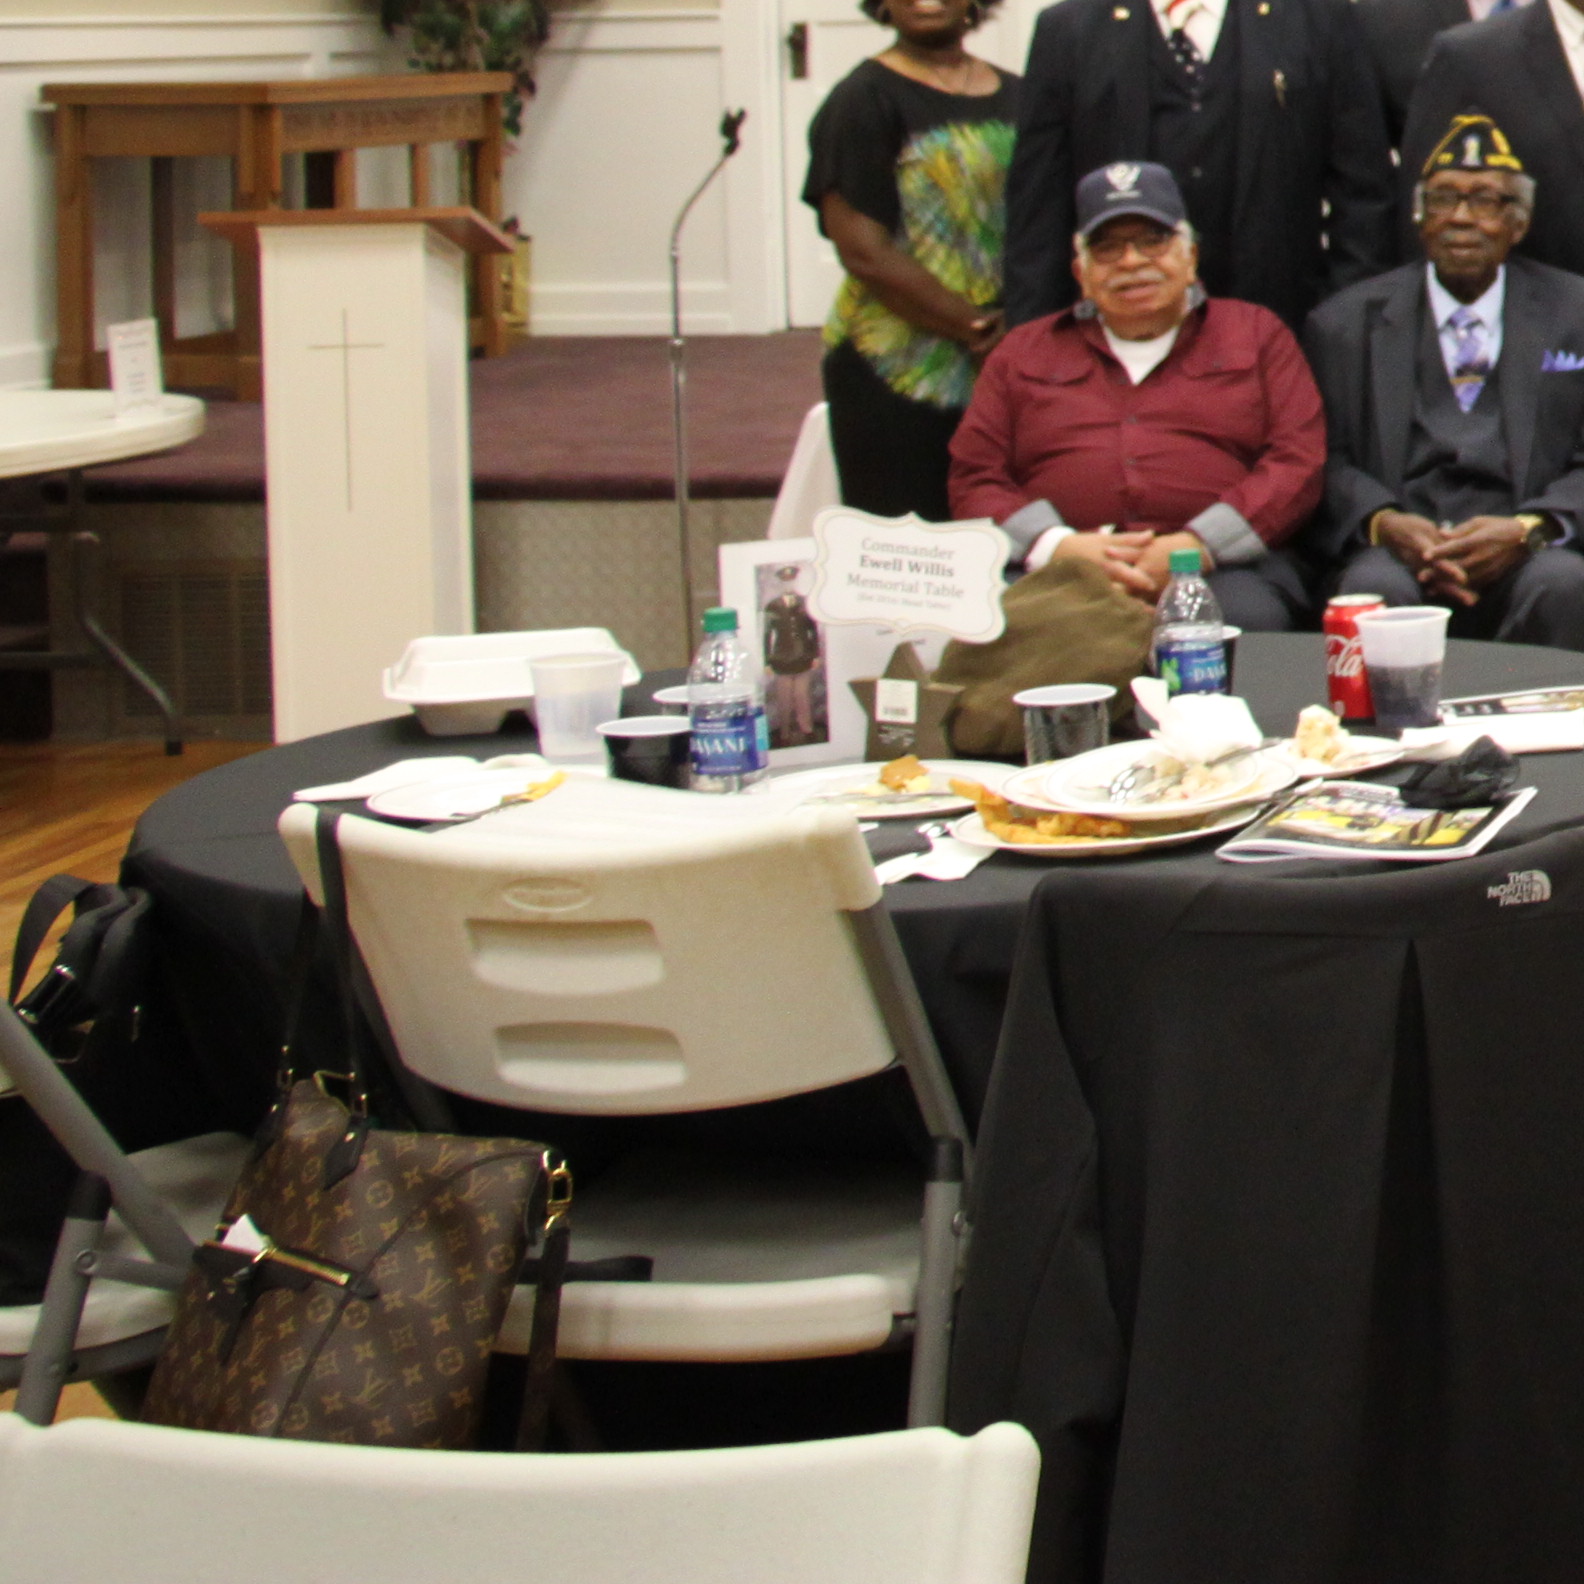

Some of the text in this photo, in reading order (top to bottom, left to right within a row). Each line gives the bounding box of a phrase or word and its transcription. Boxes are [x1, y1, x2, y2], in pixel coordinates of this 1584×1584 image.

[861, 537, 955, 560] Commander
[860, 554, 954, 577] Ewell Willis
[846, 572, 965, 598] Memorial Table
[1507, 871, 1531, 884] THE
[1487, 881, 1531, 899] NORTH
[1499, 893, 1531, 907] FACE
